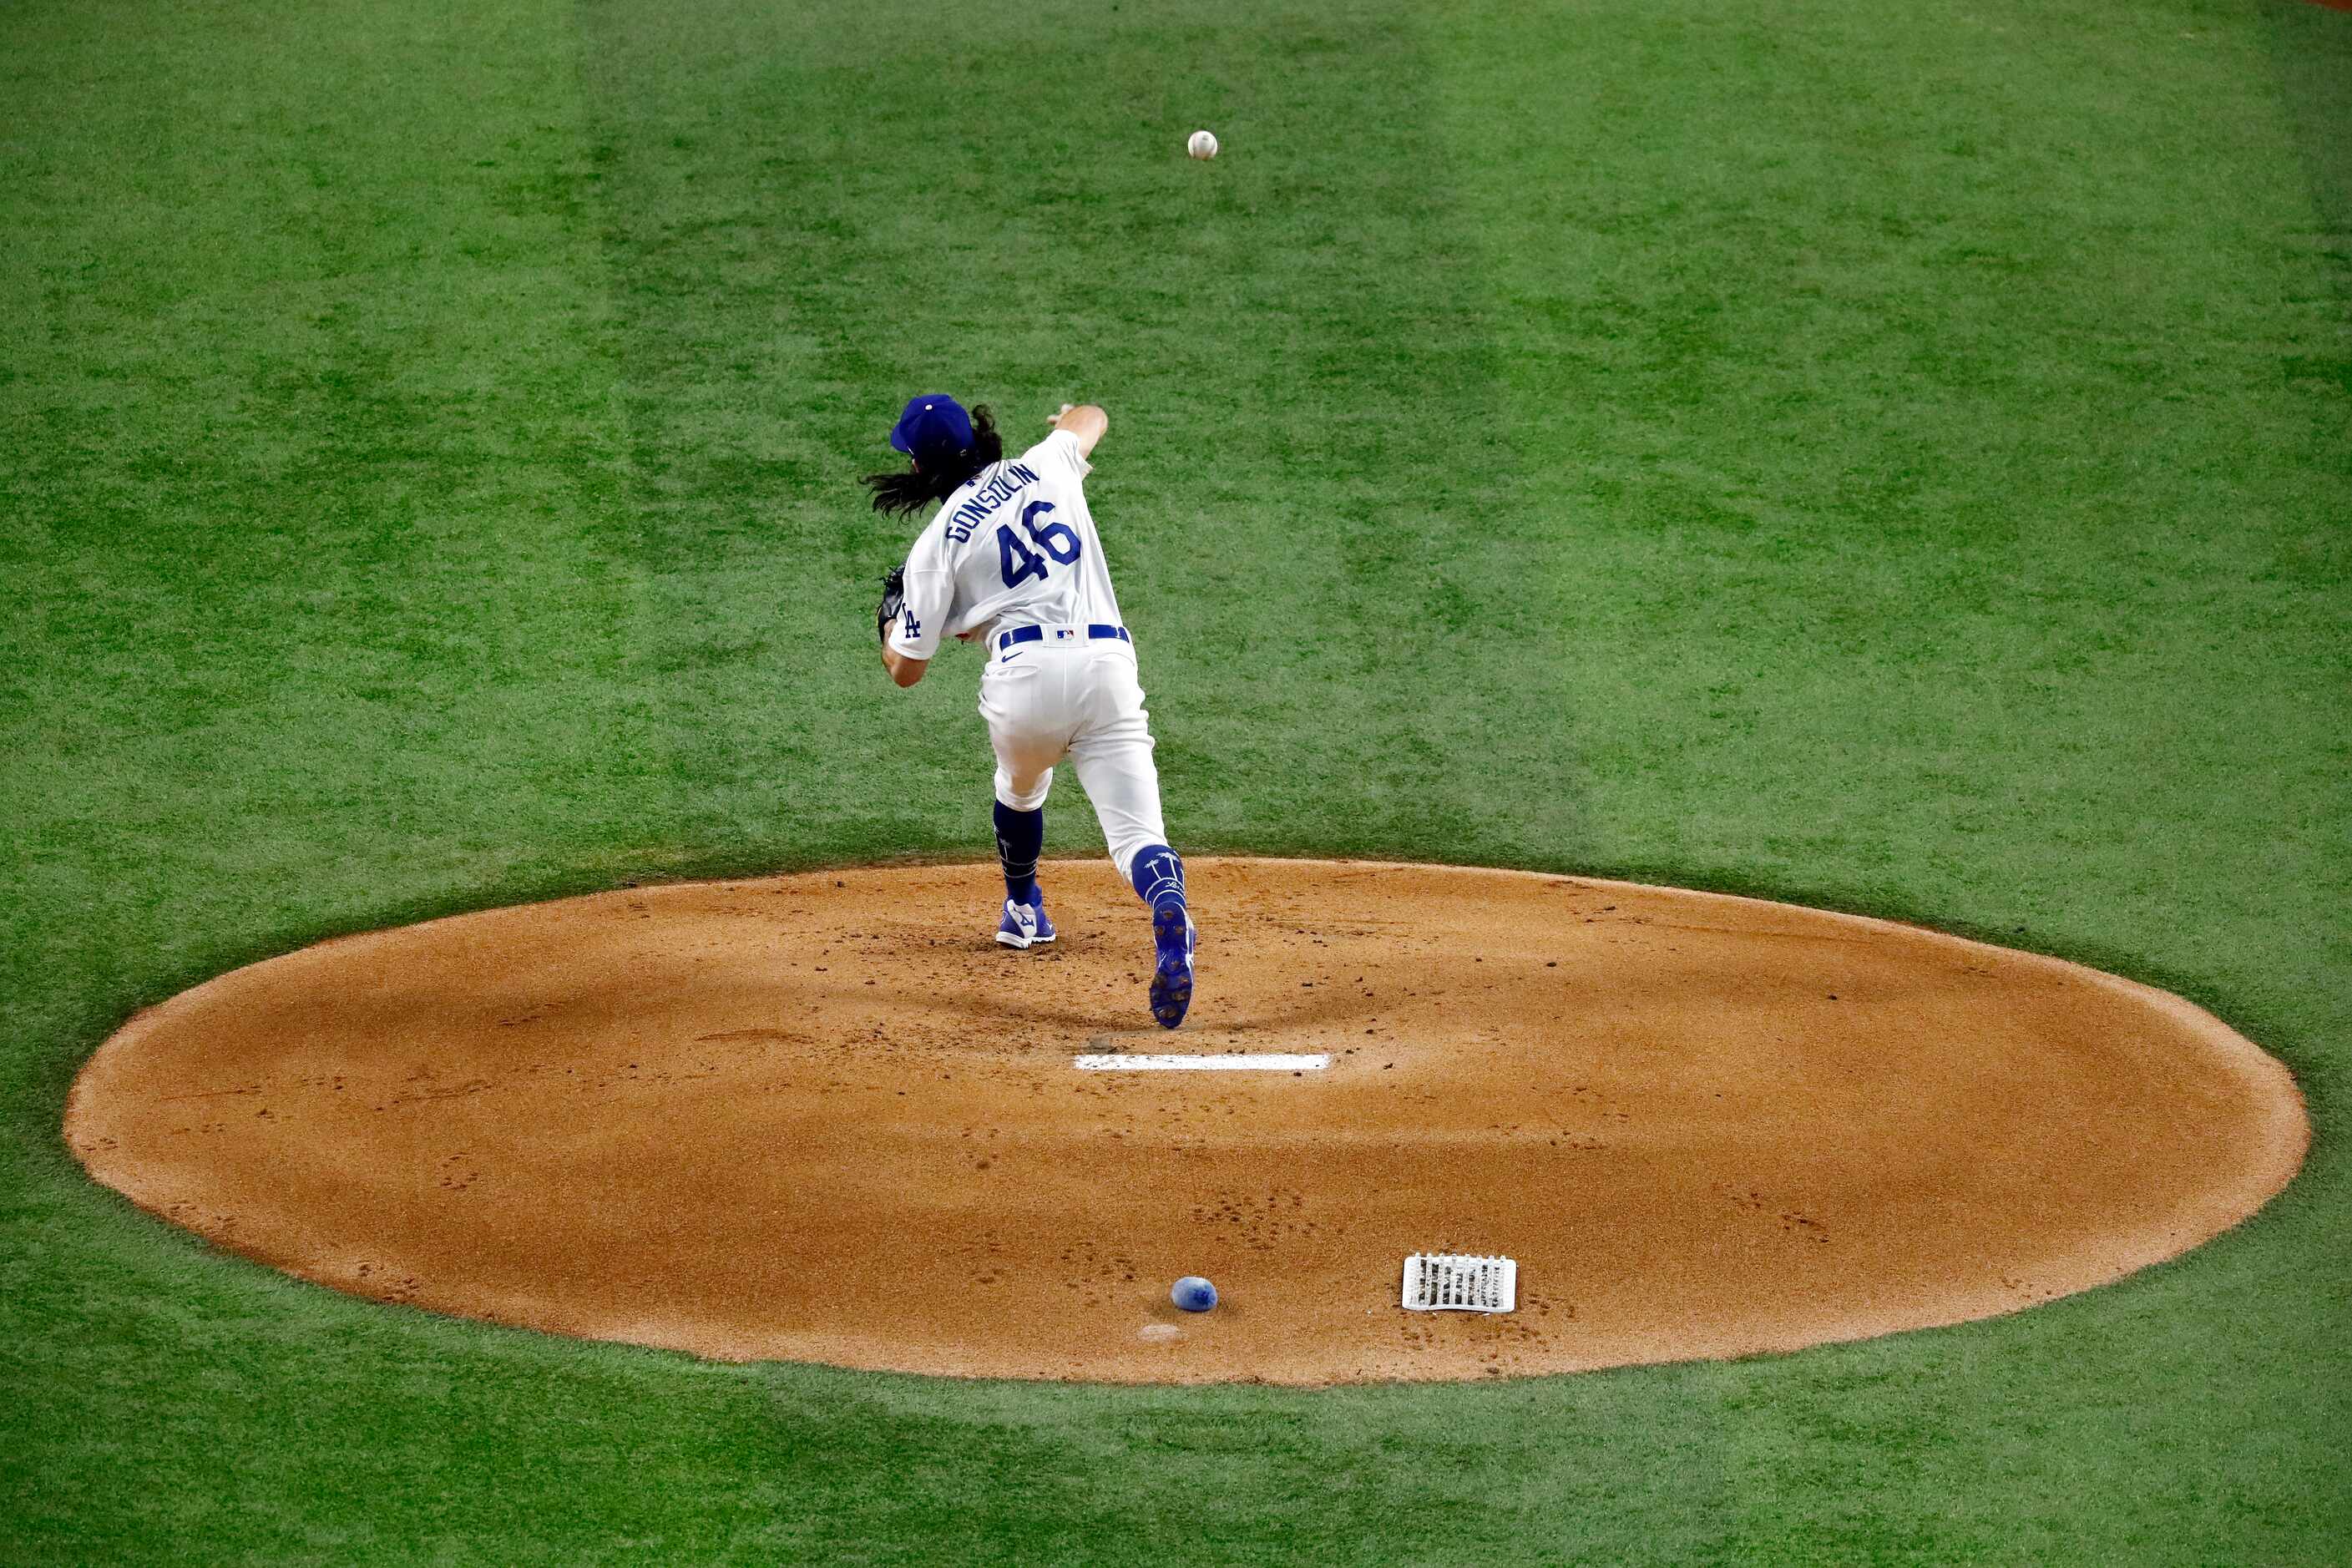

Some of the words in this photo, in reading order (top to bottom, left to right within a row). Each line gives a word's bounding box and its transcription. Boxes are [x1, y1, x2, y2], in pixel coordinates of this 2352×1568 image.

[945, 463, 1040, 544] GONSOLIN
[996, 500, 1082, 589] 46
[902, 602, 921, 639] LA
